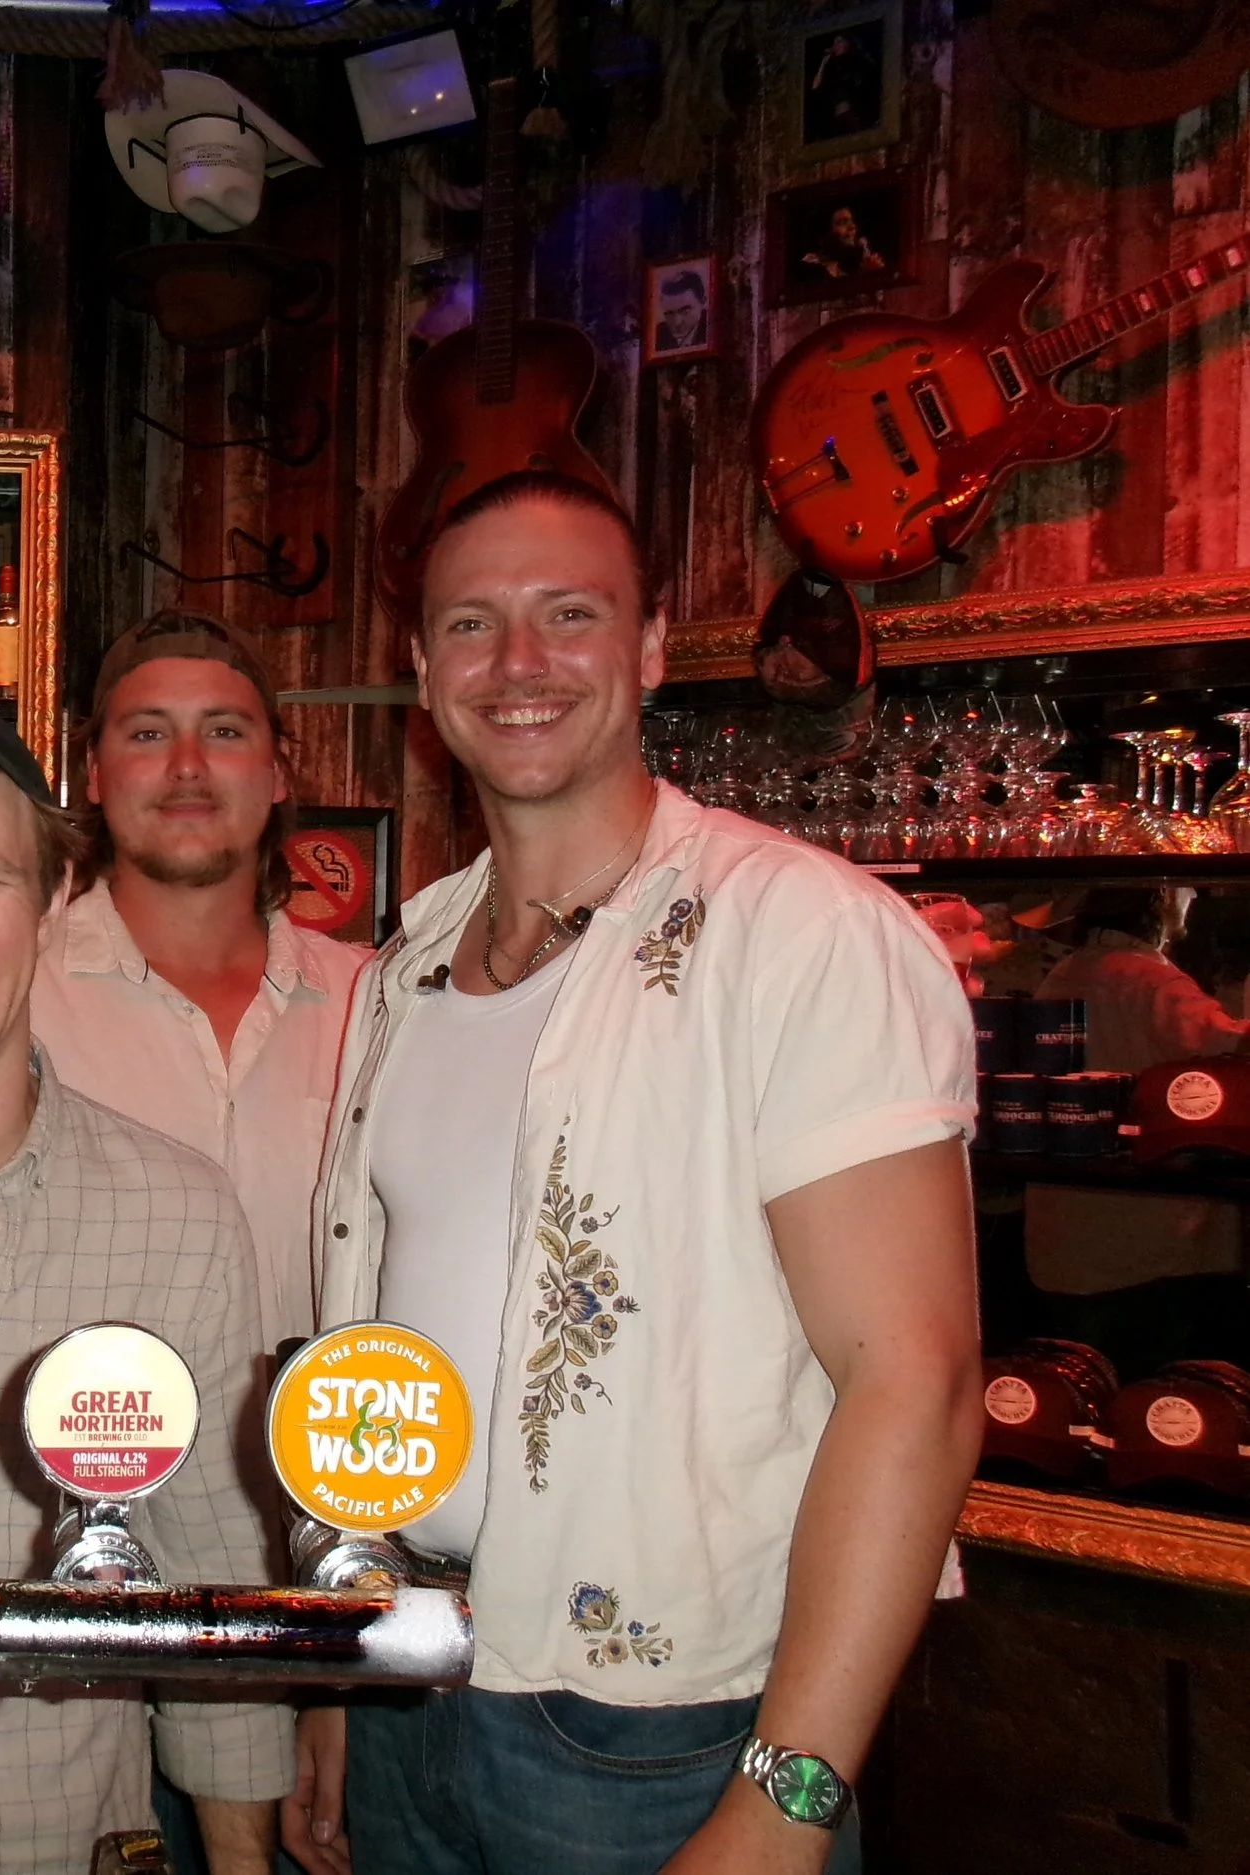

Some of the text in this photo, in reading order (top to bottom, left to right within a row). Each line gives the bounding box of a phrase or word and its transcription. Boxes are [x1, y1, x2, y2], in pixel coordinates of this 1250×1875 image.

[321, 1340, 432, 1373] THE ORIGINAL
[71, 1390, 152, 1413] GREAT
[307, 1376, 441, 1427] STONE
[59, 1414, 163, 1432] NORTHERN
[350, 1399, 404, 1458] &
[88, 1433, 122, 1442] BREWING
[72, 1452, 148, 1465] ORIGINAL 4.2%
[306, 1430, 437, 1478] WOOD
[73, 1465, 146, 1478] FULL STRENGTH
[312, 1480, 426, 1518] PACIFIC ALE
